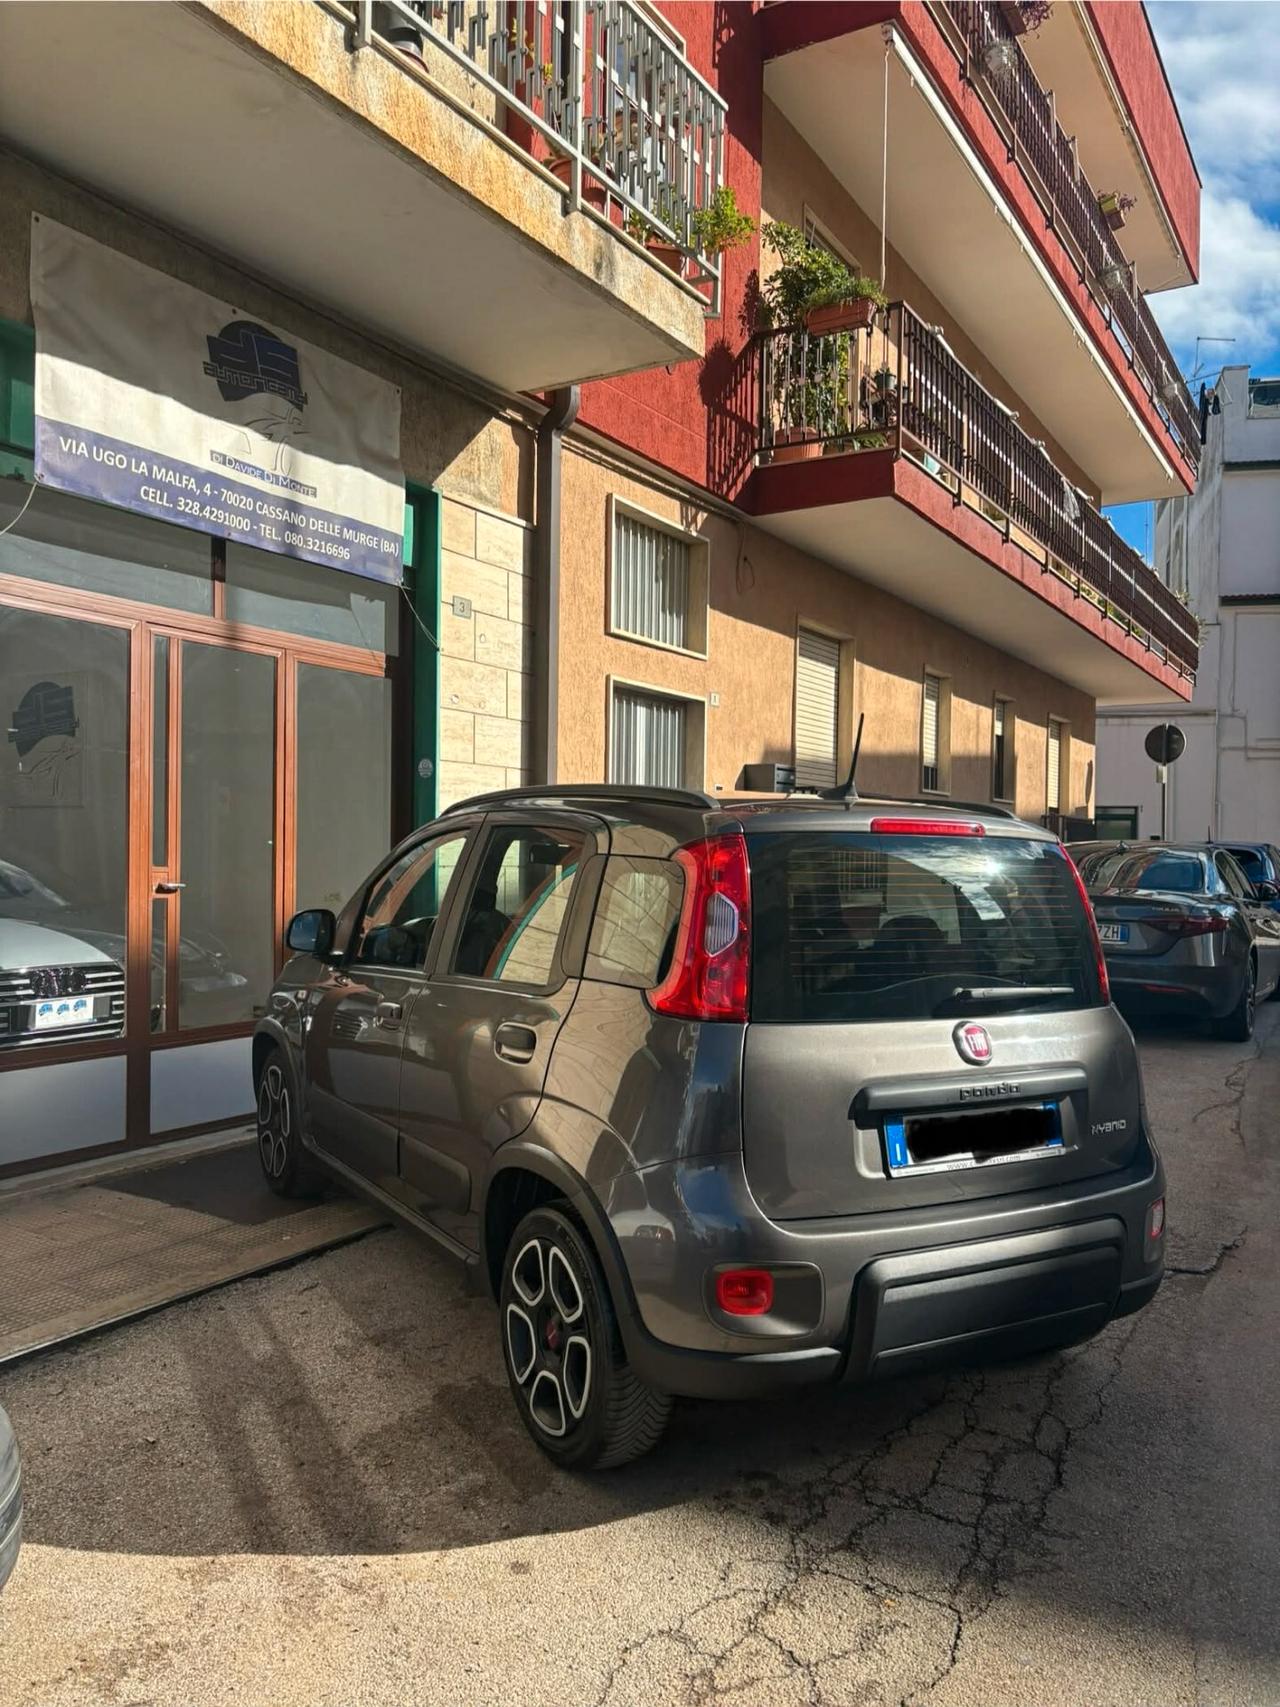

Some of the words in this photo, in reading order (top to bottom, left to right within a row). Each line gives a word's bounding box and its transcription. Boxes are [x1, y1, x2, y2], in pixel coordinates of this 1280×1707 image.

[59, 437, 89, 458] VIA
[92, 446, 127, 469] UGO
[131, 458, 149, 477] LA
[152, 465, 201, 496] MALFA,
[203, 483, 212, 497] 4
[221, 488, 254, 512] 70020
[256, 501, 306, 528] CASSANO
[309, 518, 341, 538] DELLE
[342, 527, 379, 549] MURGE
[380, 538, 400, 558] (BA)
[140, 485, 174, 508] CELL.
[177, 497, 251, 532] 328.4291000
[260, 524, 282, 542] TEL.
[284, 531, 351, 561] 080.3216696
[458, 601, 466, 614] 3
